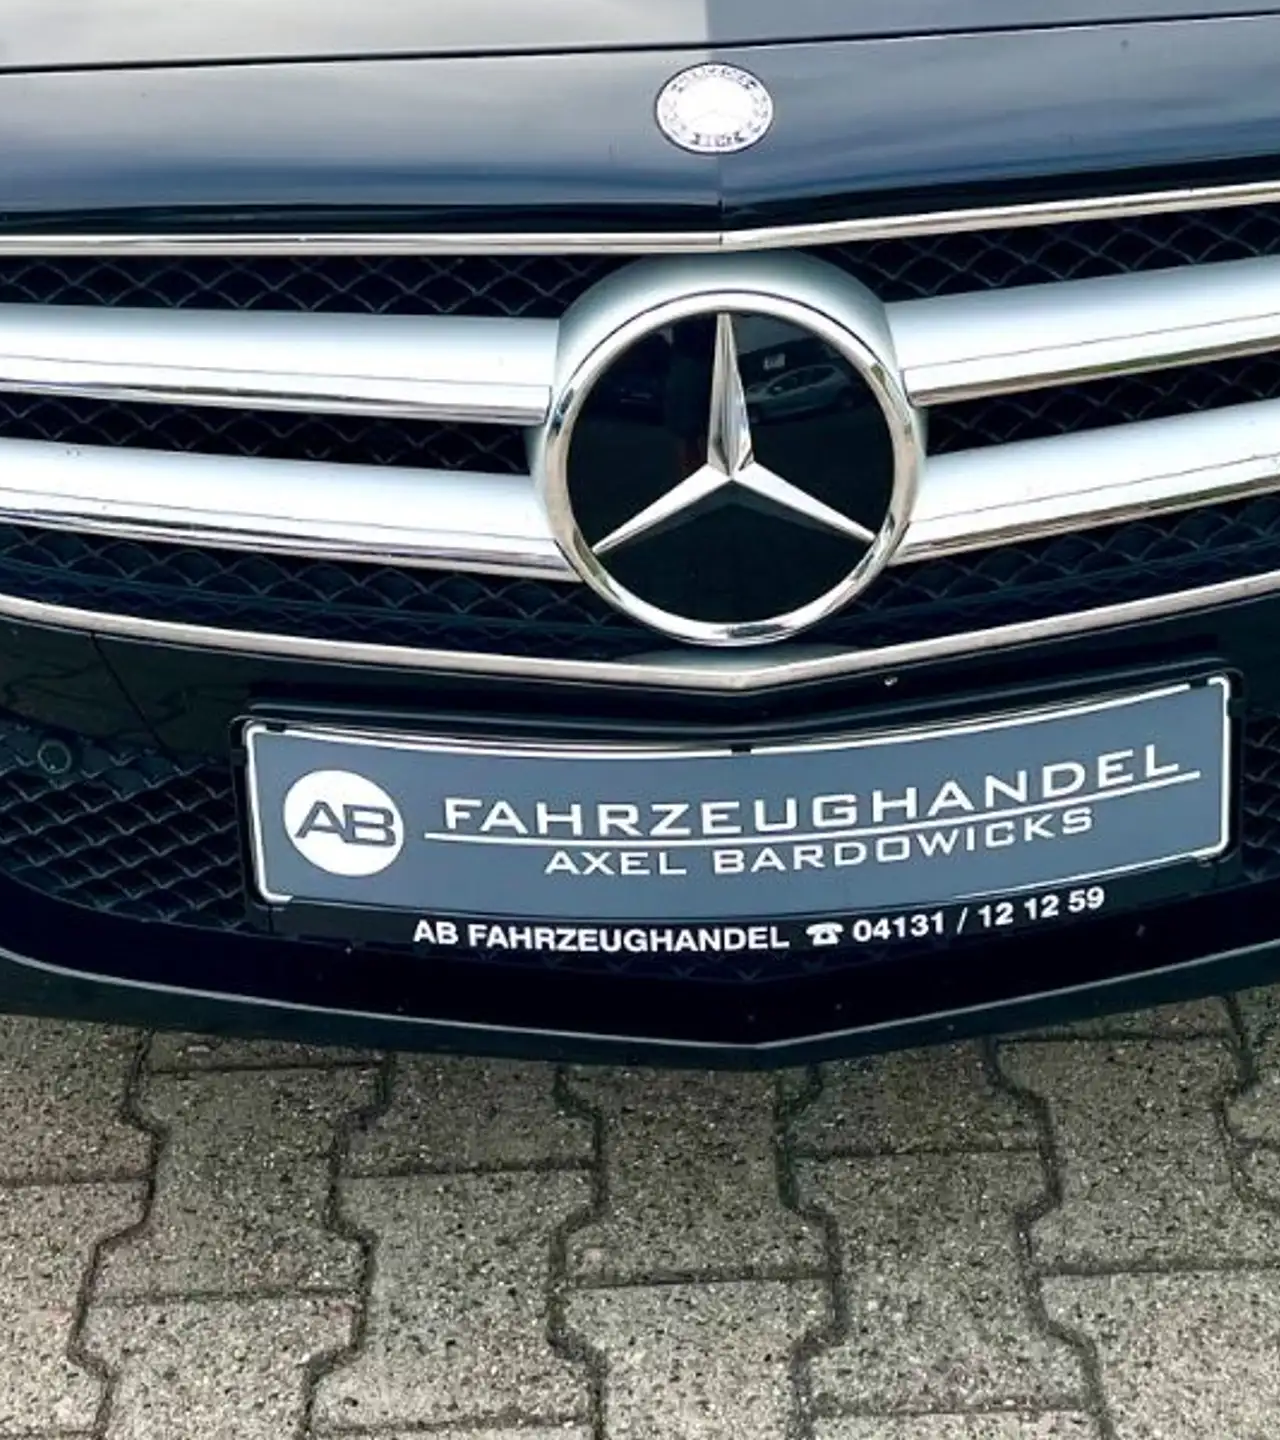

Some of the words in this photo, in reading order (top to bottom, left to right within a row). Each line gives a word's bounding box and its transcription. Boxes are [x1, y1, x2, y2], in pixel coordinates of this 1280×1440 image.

[294, 800, 397, 848] AB
[443, 743, 1180, 837] FAHRZEUGHANDEL
[543, 849, 688, 877] AXEL
[712, 807, 1095, 876] BARDOWICKS
[413, 919, 459, 946] AB
[468, 923, 790, 953] FAHRZEUGHANDEL
[851, 910, 945, 943] 04131
[977, 901, 1014, 929] 12
[1023, 893, 1060, 921] 12
[1068, 885, 1106, 913] 59
